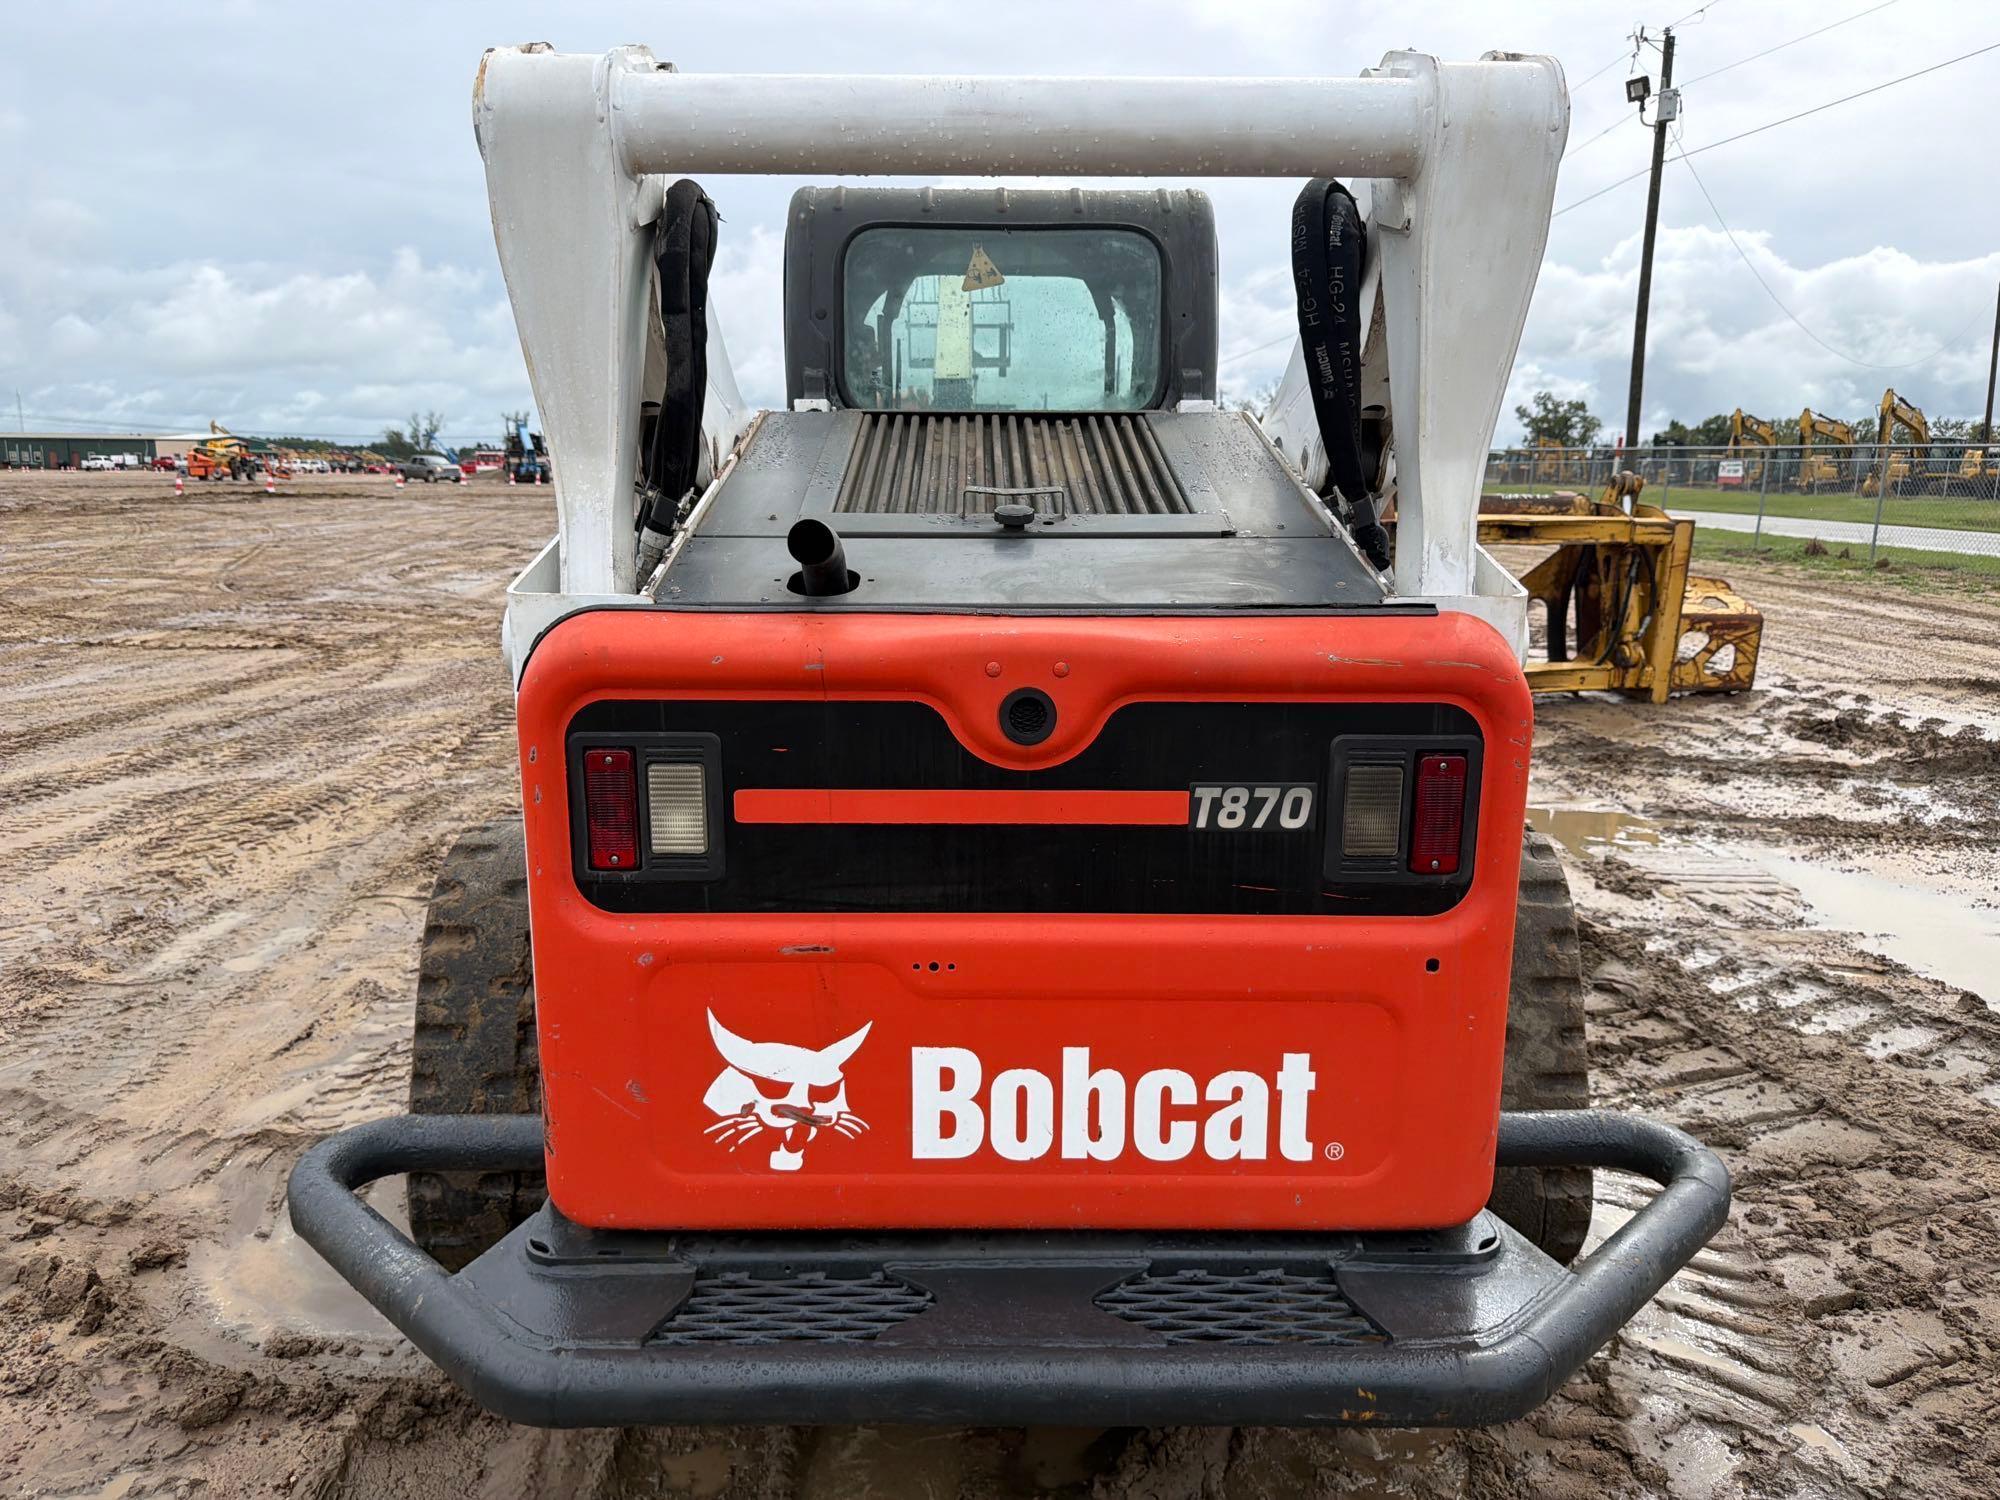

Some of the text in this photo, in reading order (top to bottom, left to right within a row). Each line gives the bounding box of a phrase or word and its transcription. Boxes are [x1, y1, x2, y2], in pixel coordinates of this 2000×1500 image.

[1329, 214, 1344, 247] Bobcat
[1194, 787, 1313, 829] T870
[911, 1046, 1317, 1162] Bobcat
